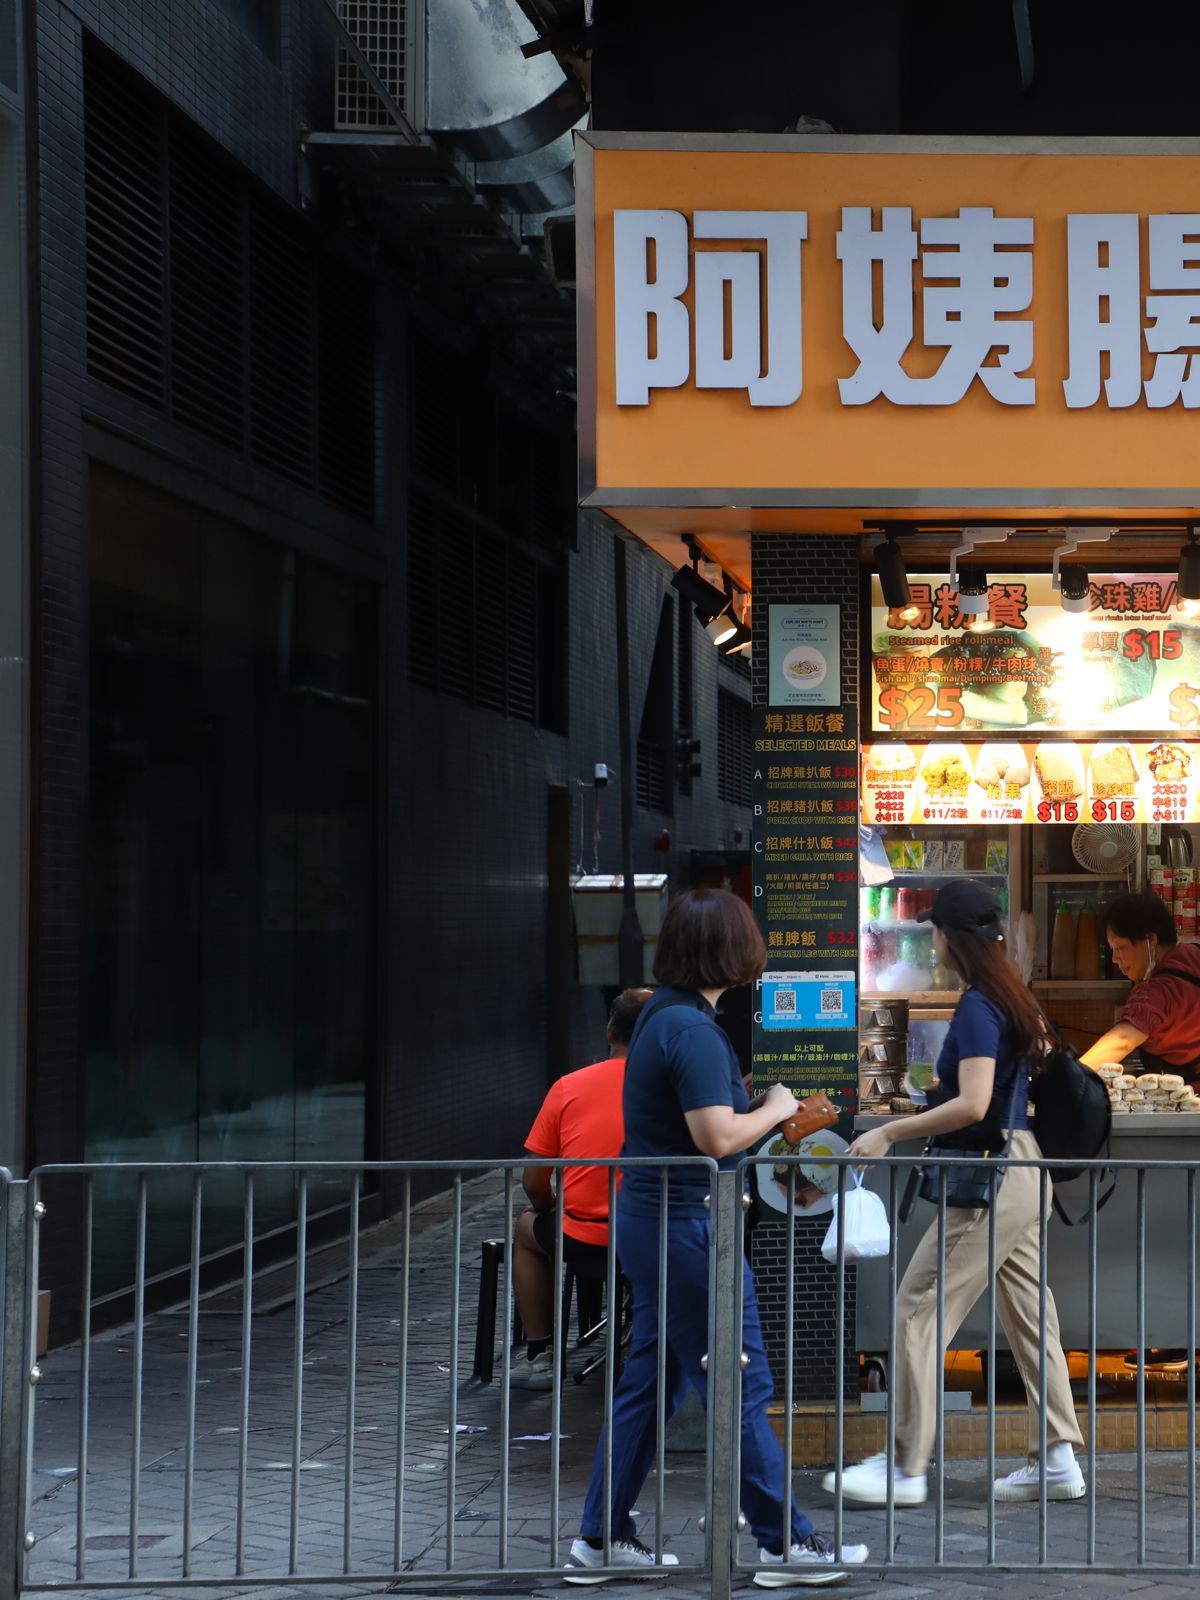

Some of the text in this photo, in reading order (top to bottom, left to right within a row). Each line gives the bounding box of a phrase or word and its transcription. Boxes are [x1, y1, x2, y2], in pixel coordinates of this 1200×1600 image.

[889, 635, 939, 645] Steamed
[941, 635, 961, 645] rice
[965, 635, 984, 645] roll
[1122, 630, 1184, 662] $15
[878, 687, 965, 730] $25
[764, 713, 846, 734] 精選飯餐
[754, 739, 857, 751] SELECTED MEALS
[754, 769, 763, 780] A
[767, 766, 832, 779] 招牌雞扒飯
[986, 783, 1022, 800] 粉果
[754, 804, 763, 816] B
[767, 799, 834, 813] 招牌豬扒飯
[1037, 801, 1079, 822] $15
[1092, 799, 1136, 822] $15
[837, 816, 856, 825] RICE
[754, 842, 763, 853] C
[765, 836, 834, 850] 招牌什扒飯
[835, 853, 854, 861] RICE
[754, 885, 763, 897] D
[826, 930, 856, 945] $32
[753, 1011, 763, 1024] G
[794, 1044, 824, 1052] 以上可配
